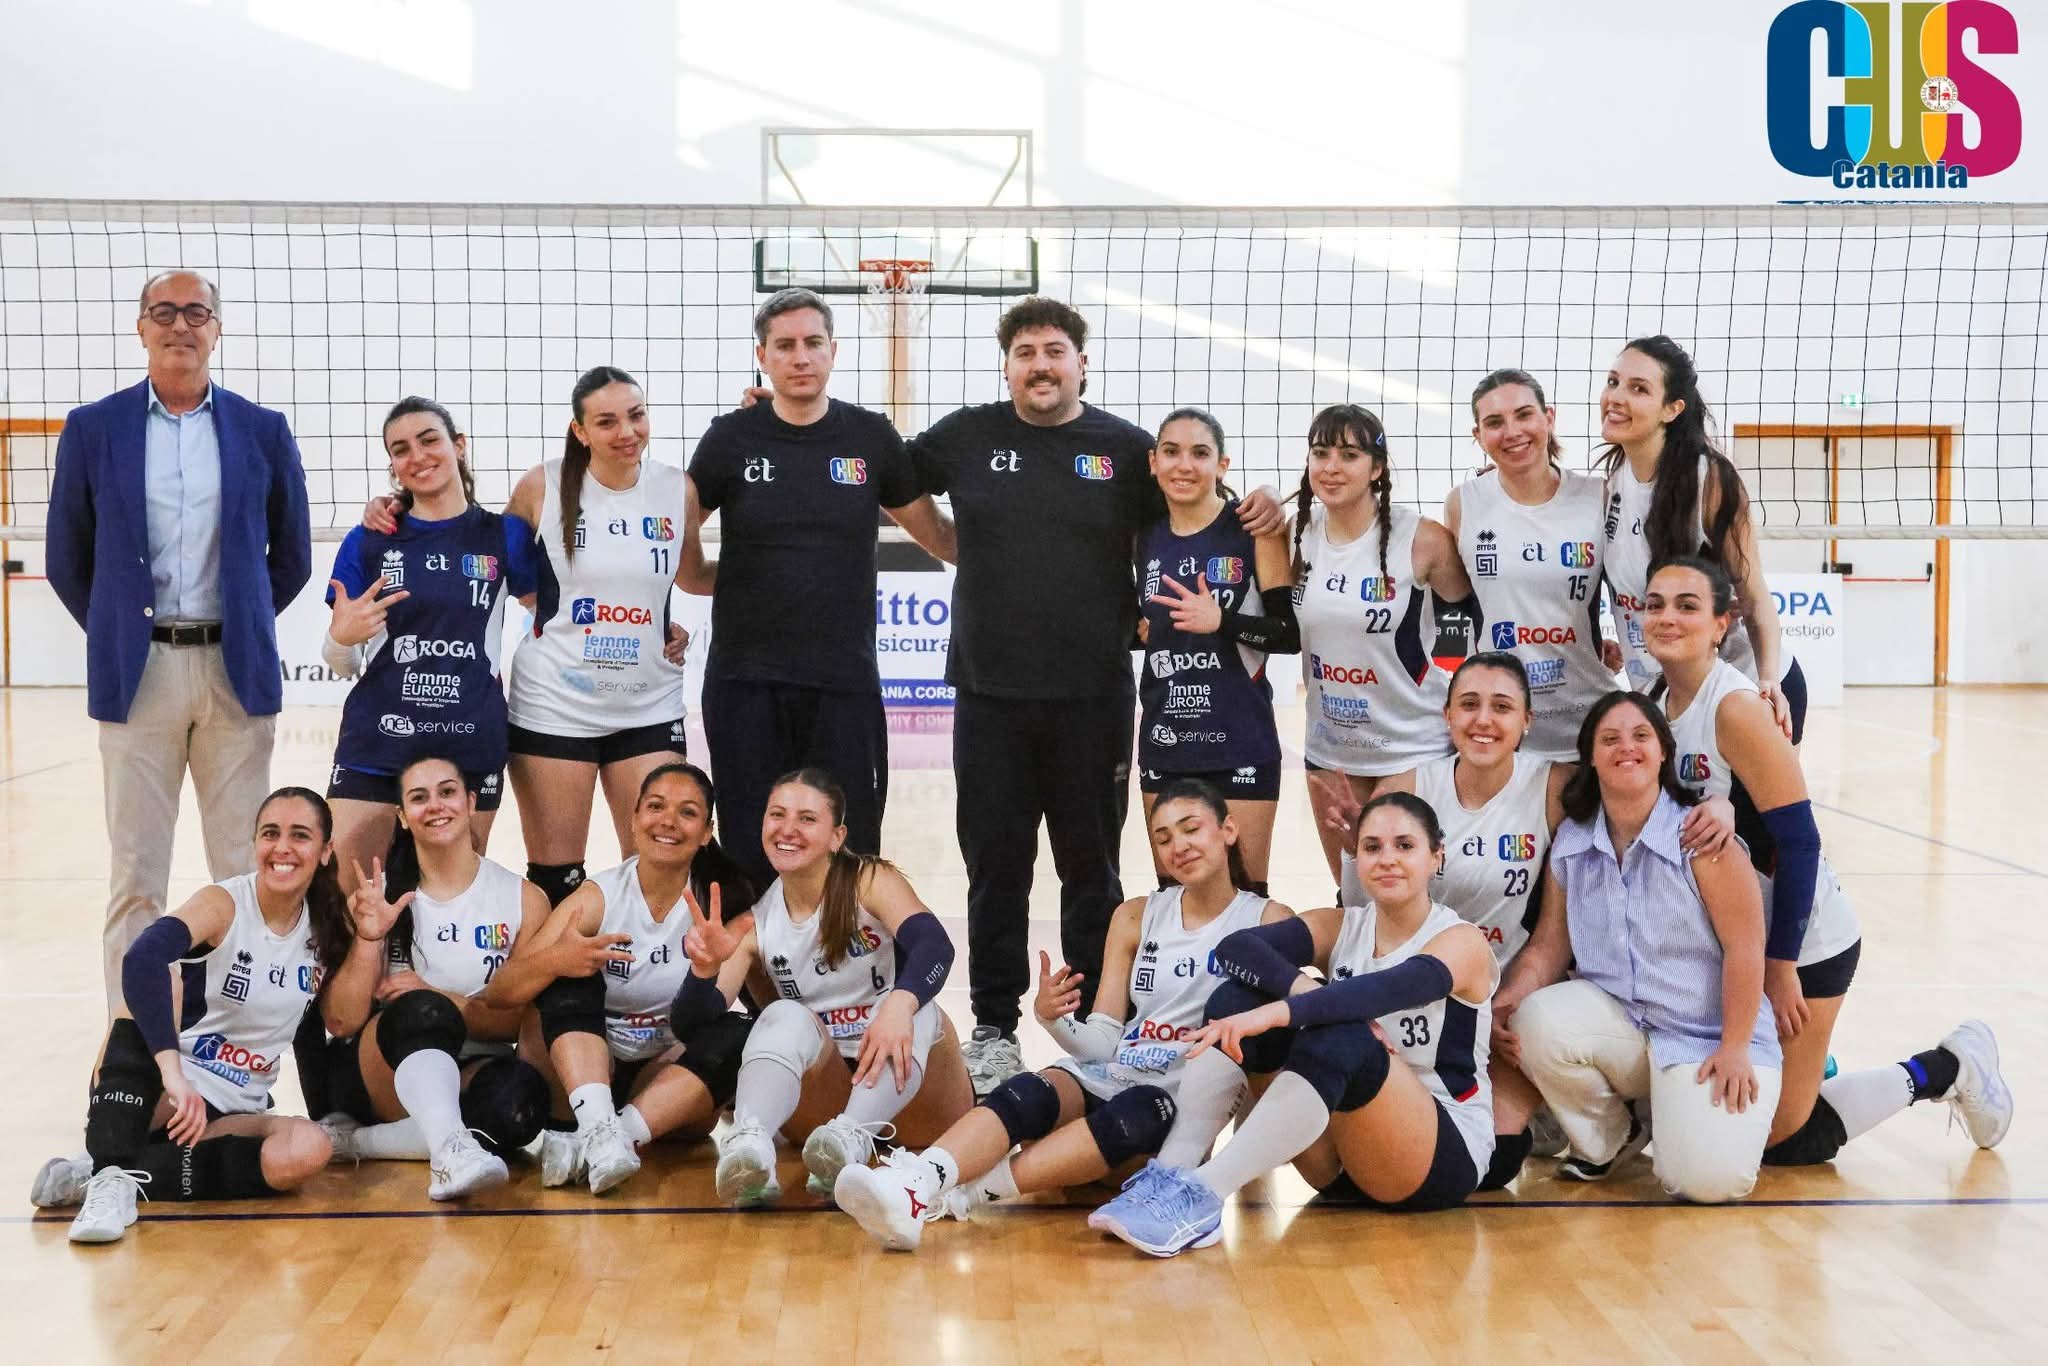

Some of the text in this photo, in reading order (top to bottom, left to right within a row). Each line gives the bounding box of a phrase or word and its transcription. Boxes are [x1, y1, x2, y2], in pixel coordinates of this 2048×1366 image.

[1767, 0, 2022, 178] CUS
[1832, 159, 1968, 189] Catania
[651, 547, 669, 575] 11
[469, 580, 490, 609] 14
[1568, 575, 1589, 602] 15
[597, 604, 653, 625] ROGA
[1365, 608, 1392, 634] 22
[584, 627, 640, 649] iemme
[1517, 626, 1577, 645] ROGA
[418, 640, 477, 660] ROGA
[583, 647, 639, 660] EUROPA
[402, 666, 461, 687] iemme
[1322, 663, 1379, 685] ROGA
[402, 683, 460, 698] EUROPA
[416, 720, 475, 734] service
[1178, 730, 1227, 743] service
[1504, 868, 1529, 897] 23
[871, 965, 885, 990] 6
[1400, 1015, 1431, 1048] 33
